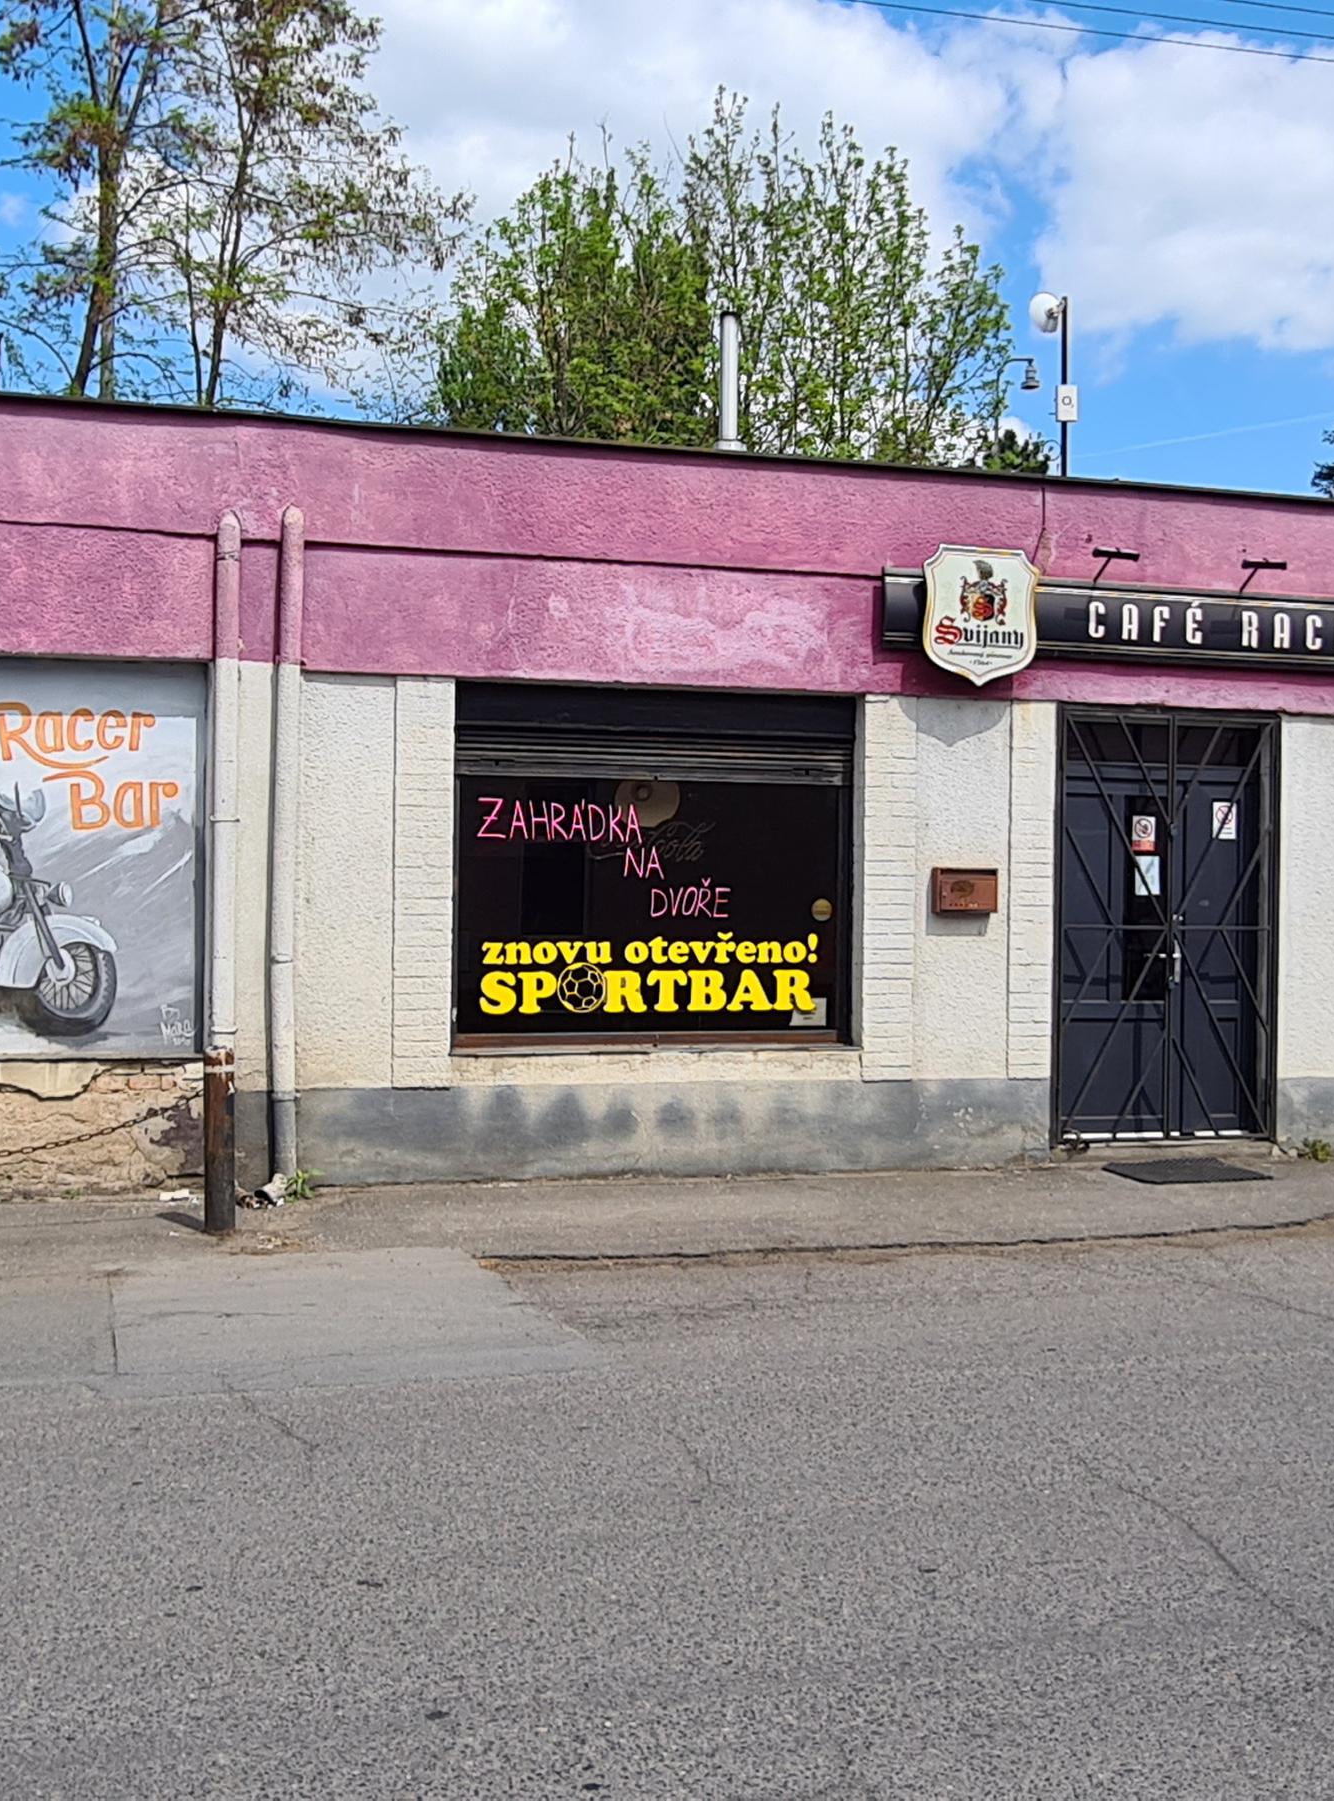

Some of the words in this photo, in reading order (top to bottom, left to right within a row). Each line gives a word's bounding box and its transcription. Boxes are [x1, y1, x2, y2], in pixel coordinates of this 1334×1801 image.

[934, 615, 1024, 650] Svijany
[1088, 601, 1203, 645] CAFÉ
[42, 770, 179, 831] Bar
[476, 797, 643, 844] ZAHRÁDKA
[624, 846, 665, 880] NA
[650, 878, 731, 918] DVOŘE
[482, 942, 612, 964] znovu
[624, 932, 818, 964] otevřeno!
